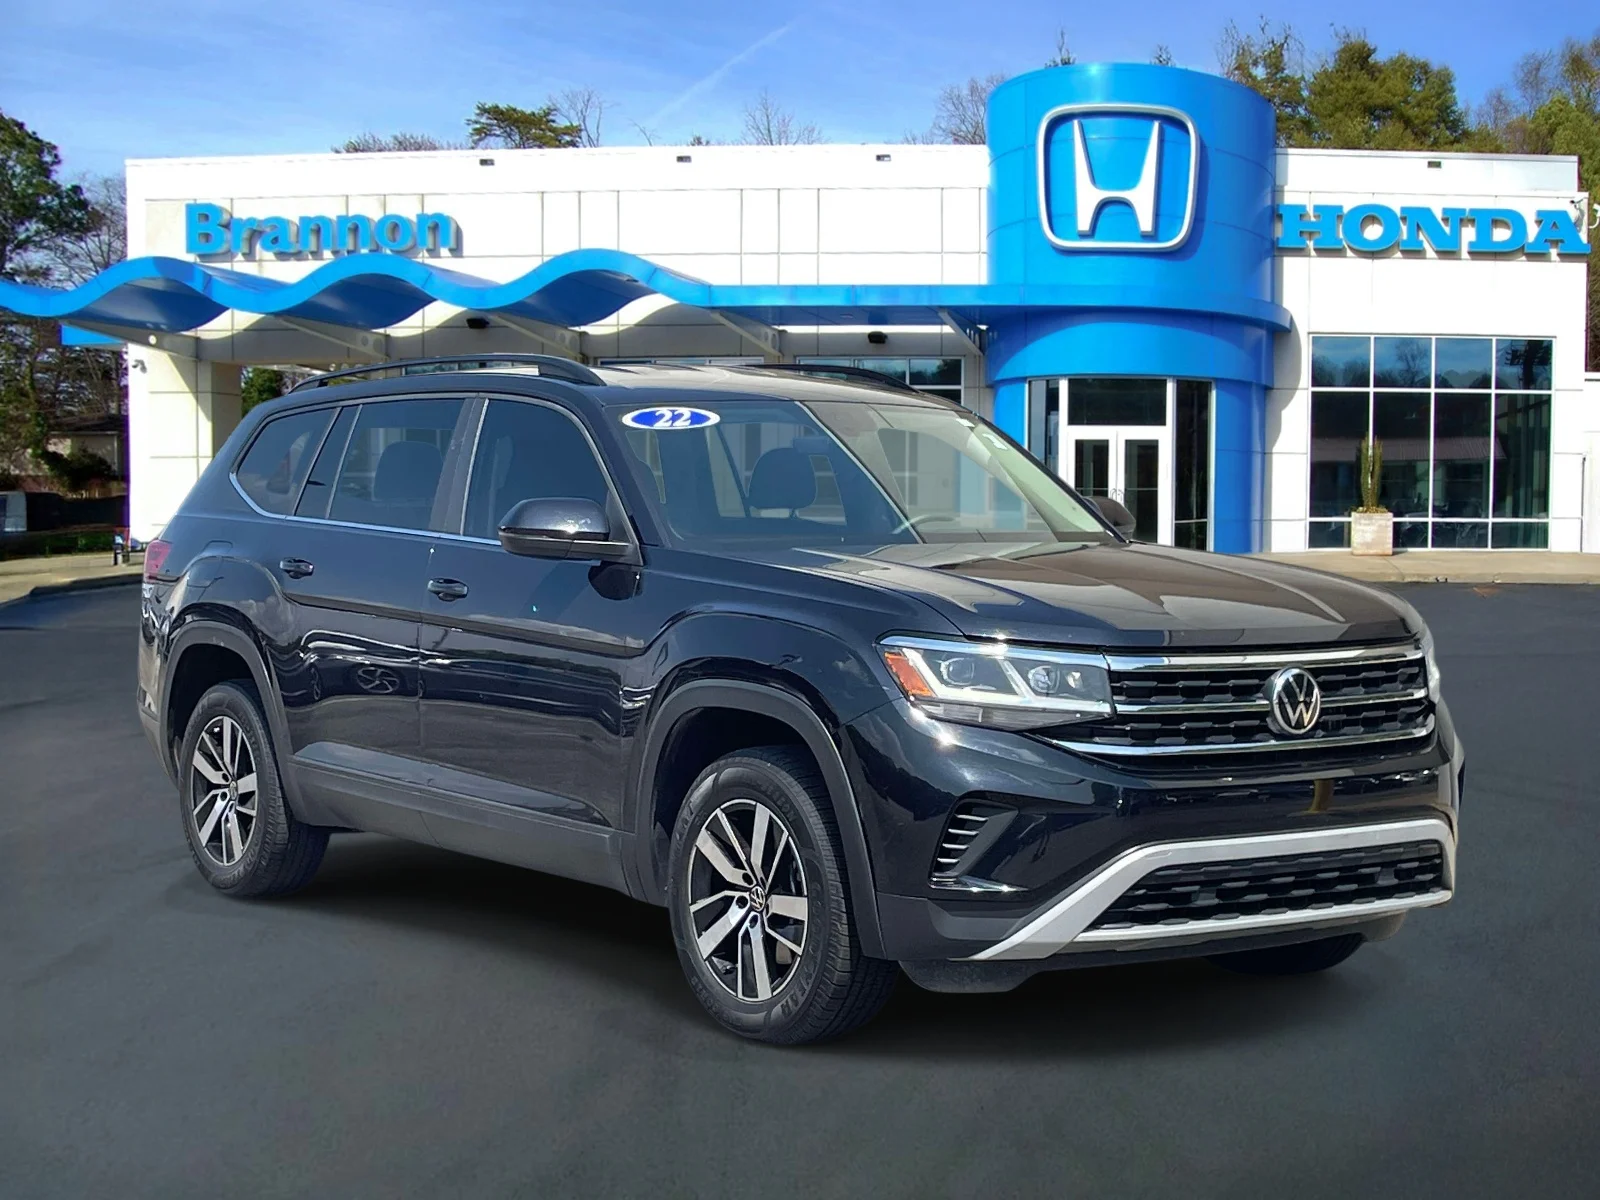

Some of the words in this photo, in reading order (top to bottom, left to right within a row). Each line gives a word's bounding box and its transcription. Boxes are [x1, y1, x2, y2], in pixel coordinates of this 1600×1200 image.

[185, 202, 454, 256] Brannon
[1276, 203, 1592, 254] HONDA
[653, 408, 692, 428] 22
